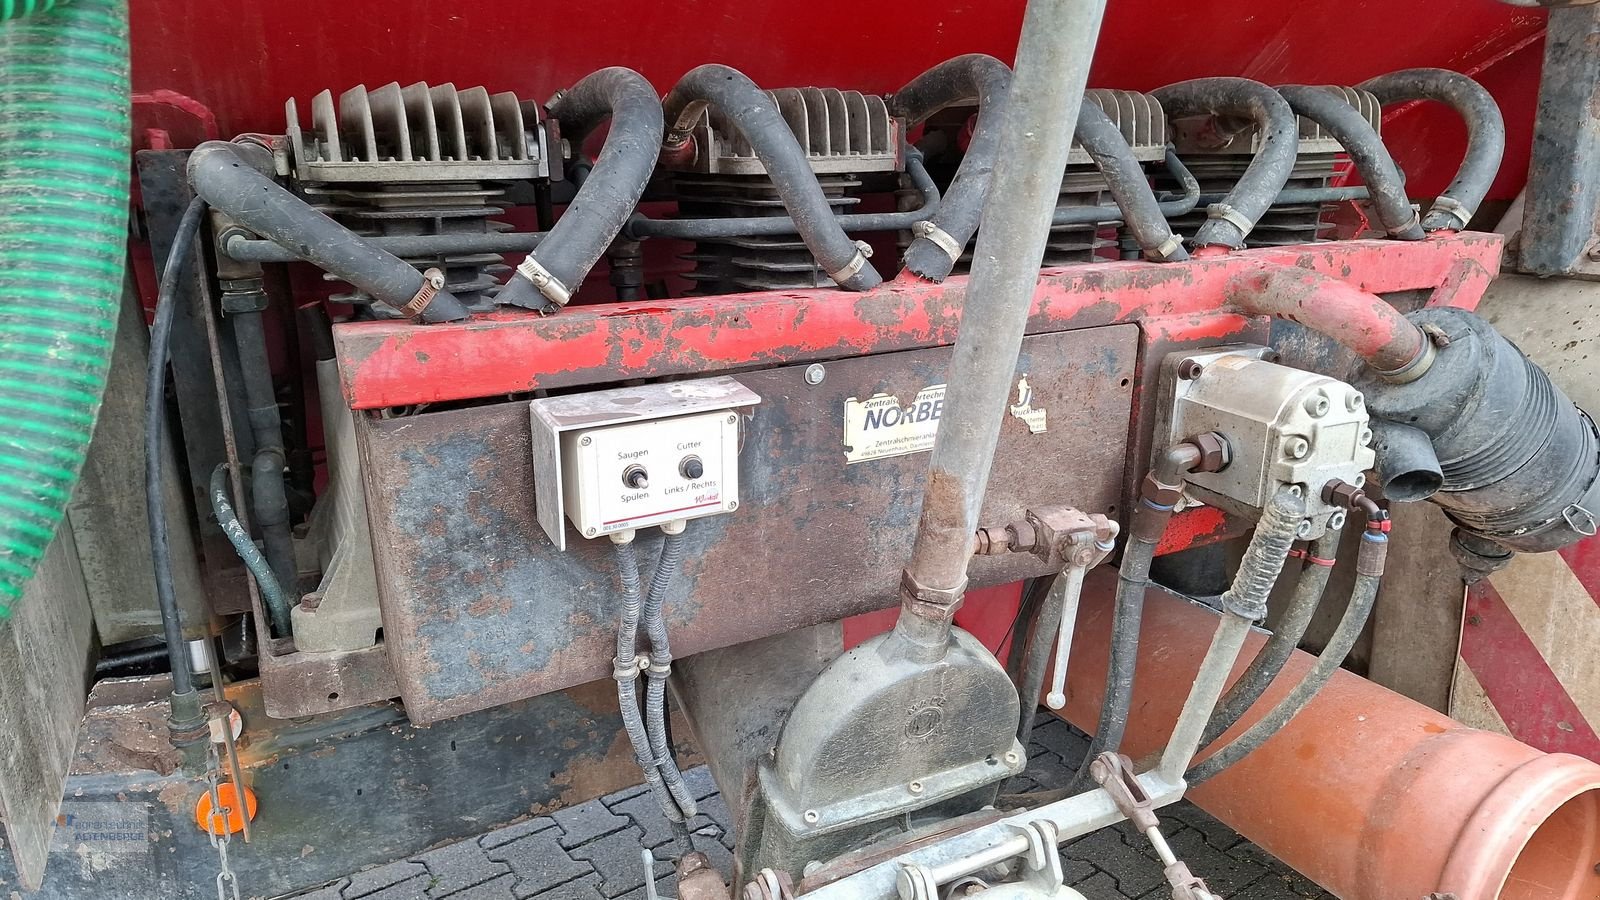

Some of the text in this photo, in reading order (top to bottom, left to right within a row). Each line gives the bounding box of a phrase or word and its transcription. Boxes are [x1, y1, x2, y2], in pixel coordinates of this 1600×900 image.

[863, 400, 944, 431] NORBE
[676, 440, 702, 451] Cutter
[617, 449, 649, 461] Saugen
[664, 485, 684, 495] Links
[691, 480, 717, 490] Rechts
